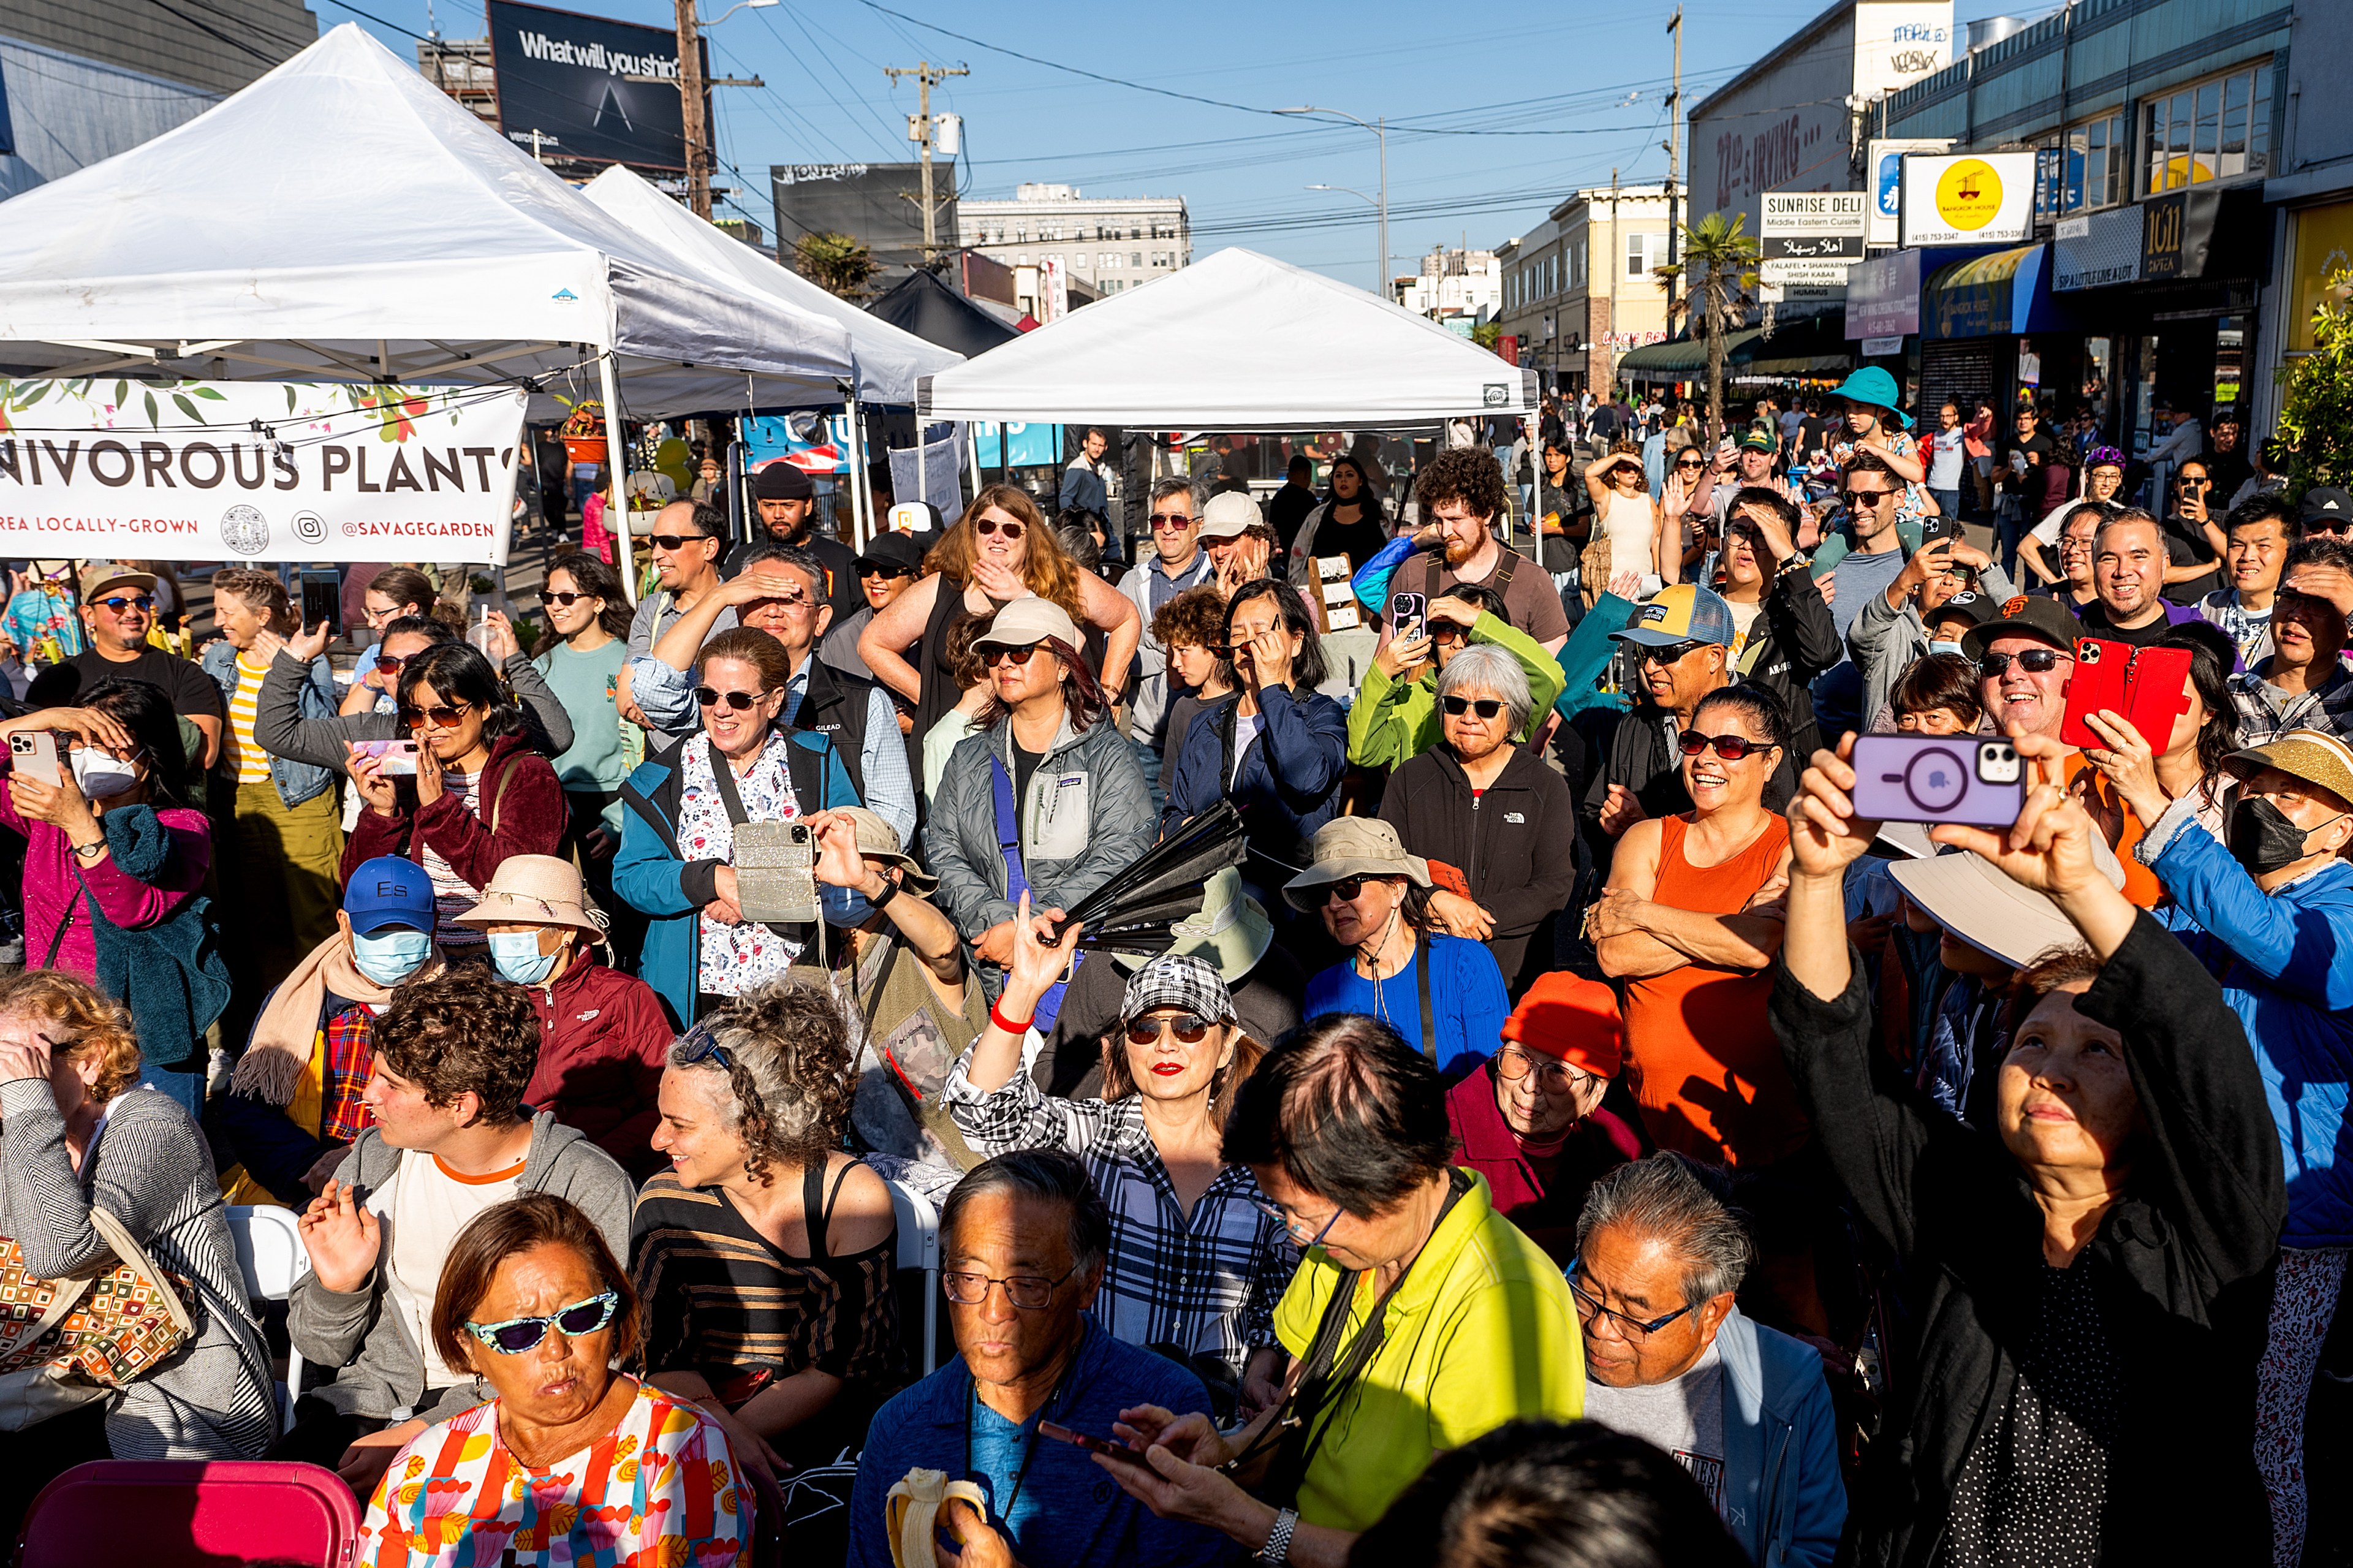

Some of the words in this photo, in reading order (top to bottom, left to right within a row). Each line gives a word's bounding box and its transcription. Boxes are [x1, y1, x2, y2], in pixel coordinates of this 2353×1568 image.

[519, 30, 575, 64] What
[574, 42, 608, 70] will
[607, 51, 640, 75] you
[509, 131, 559, 146] vercecom
[1752, 114, 1799, 194] IRVING
[1768, 198, 1826, 213] SUNRISE
[1833, 198, 1860, 212] DELI
[1930, 232, 1959, 241] 753-3347
[1979, 231, 1995, 240] (415)
[2075, 270, 2097, 286] LITTLE
[2118, 265, 2134, 280] LOT
[36, 517, 198, 534] LOCALLY-GROWN
[903, 1025, 923, 1041] Columbia
